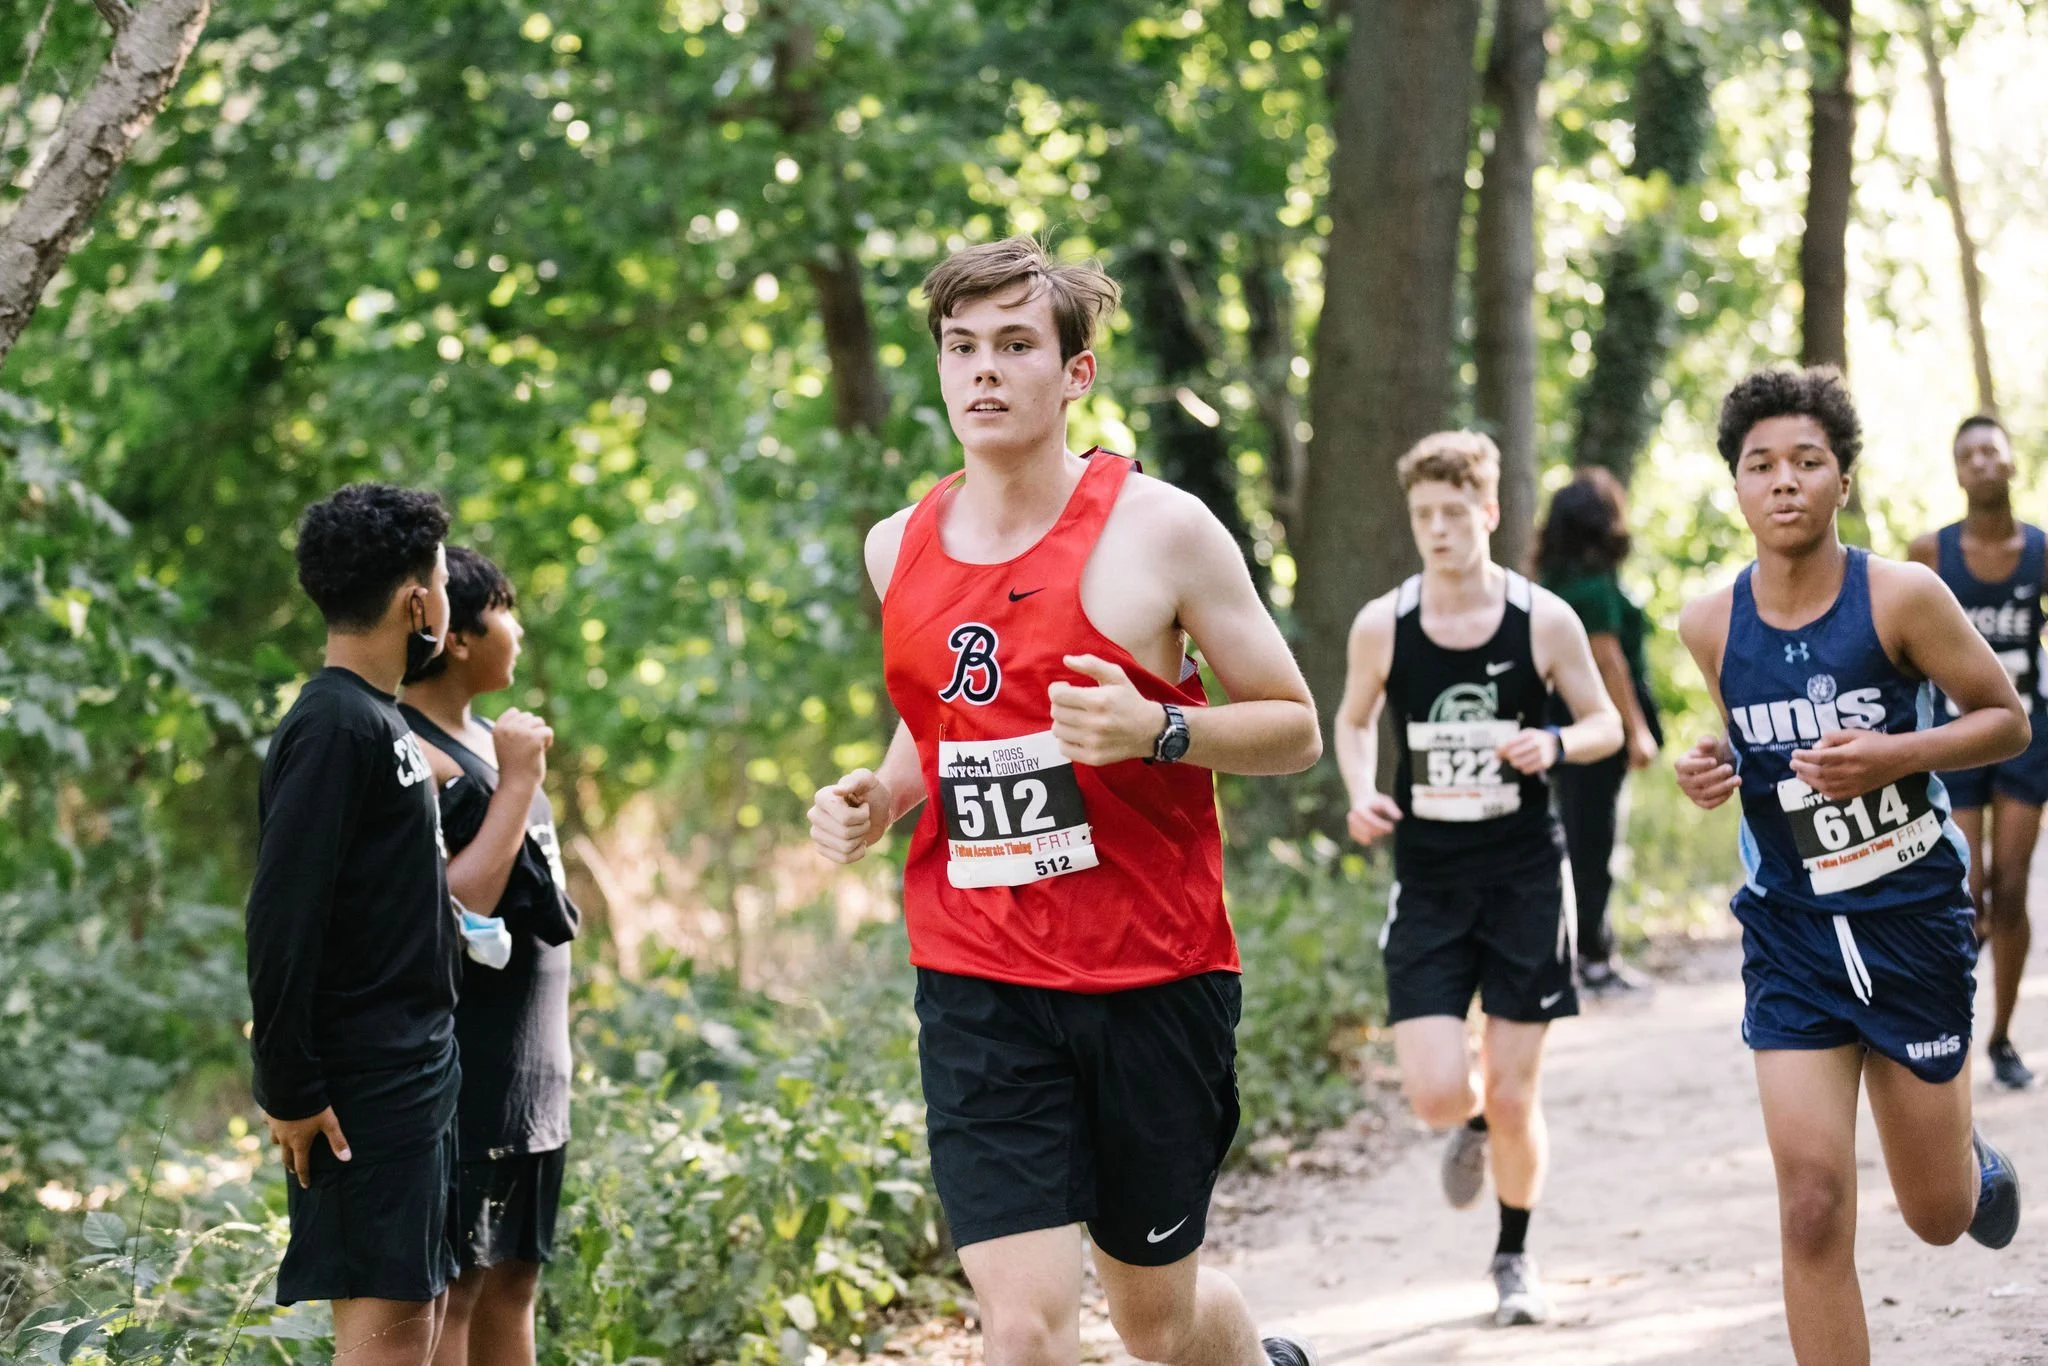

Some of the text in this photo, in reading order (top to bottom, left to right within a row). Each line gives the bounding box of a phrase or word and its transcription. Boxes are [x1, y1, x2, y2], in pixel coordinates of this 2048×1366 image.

[938, 622, 1001, 705] B
[993, 747, 1024, 762] CROSS
[948, 766, 991, 777] NYCAL
[996, 757, 1039, 775] COUNTRY
[1427, 750, 1503, 786] 522
[954, 778, 1056, 838] 512
[1813, 783, 1909, 851] 614
[974, 842, 1005, 857] Accurate
[1005, 841, 1032, 855] Timing
[1036, 831, 1071, 852] FAT
[1897, 842, 1925, 863] 614
[1035, 855, 1072, 876] 512
